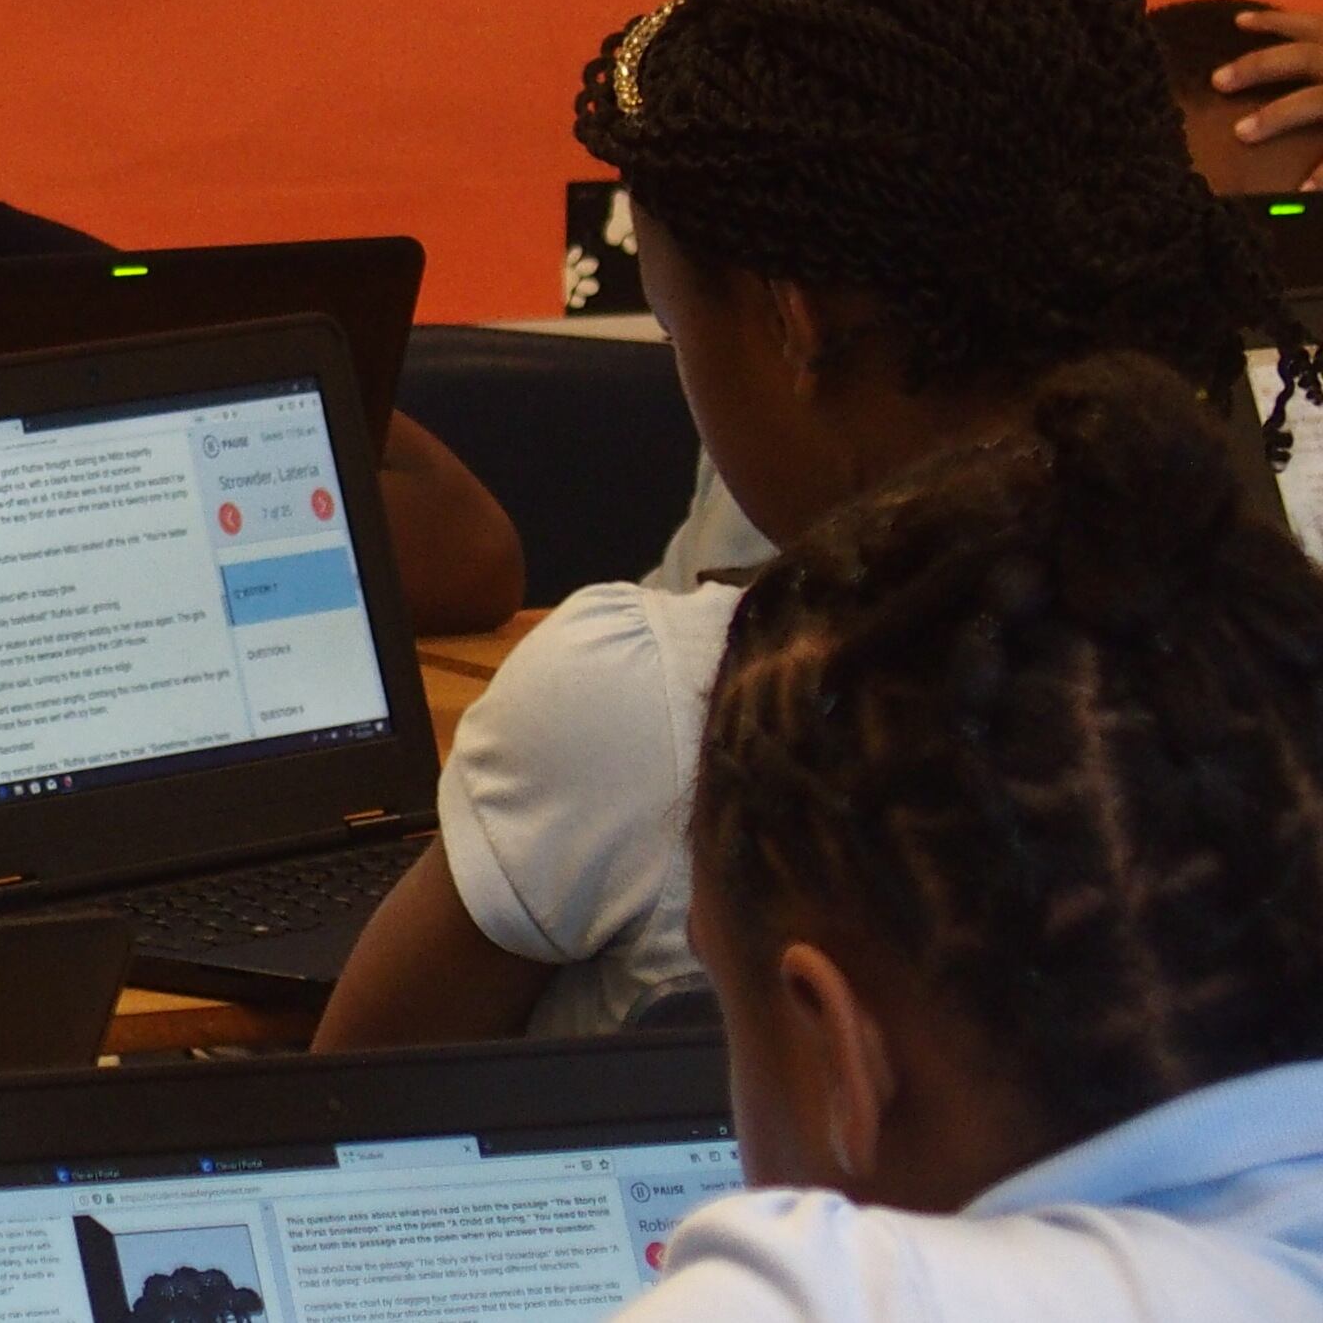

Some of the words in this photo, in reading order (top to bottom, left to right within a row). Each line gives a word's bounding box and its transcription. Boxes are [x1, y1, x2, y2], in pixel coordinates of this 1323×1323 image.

[653, 1184, 684, 1195] PAUSE
[286, 1215, 306, 1227] This
[307, 1213, 347, 1227] question
[348, 1212, 369, 1222] asks
[371, 1209, 398, 1220] about
[399, 1208, 422, 1219] what
[422, 1208, 438, 1219] you
[440, 1205, 460, 1216] read
[472, 1203, 494, 1213] both
[496, 1201, 510, 1212] the
[512, 1199, 549, 1212] passage
[574, 1195, 596, 1207] Story
[287, 1228, 303, 1239] the
[306, 1226, 327, 1238] First
[385, 1222, 403, 1233] and
[404, 1220, 420, 1231] the
[421, 1220, 445, 1232] poem
[459, 1216, 482, 1228] Child
[534, 1210, 552, 1221] You
[553, 1209, 575, 1220] need
[588, 1207, 611, 1217] think
[292, 1241, 317, 1253] about
[319, 1239, 340, 1250] both
[342, 1238, 357, 1249] the
[359, 1236, 397, 1250] passage
[398, 1234, 416, 1245] and
[417, 1233, 432, 1244] the
[433, 1233, 458, 1245] poem
[461, 1231, 485, 1241] when
[486, 1229, 504, 1241] you
[505, 1227, 537, 1238] answer
[538, 1225, 554, 1236] the
